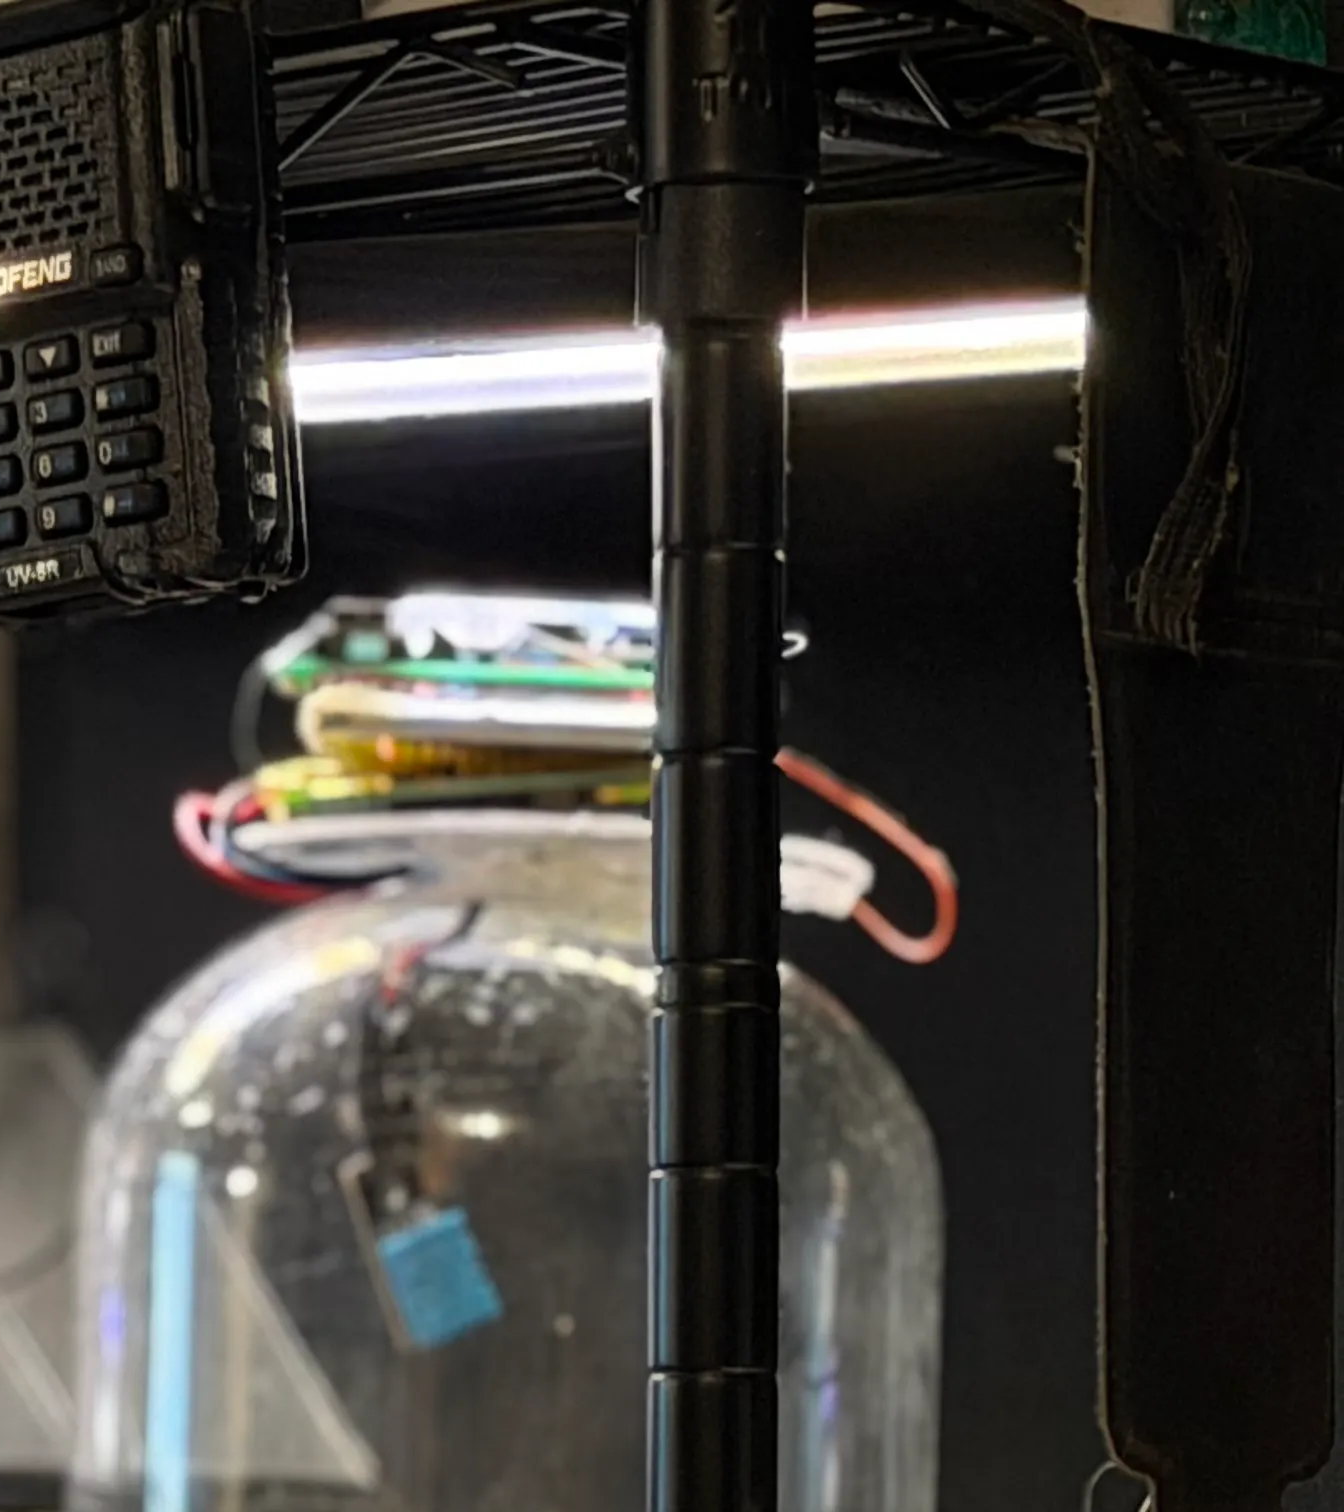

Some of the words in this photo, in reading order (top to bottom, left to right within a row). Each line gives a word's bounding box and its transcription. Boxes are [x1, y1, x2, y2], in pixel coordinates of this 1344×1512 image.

[33, 400, 48, 424] 3
[98, 440, 112, 465] 0
[42, 506, 56, 530] 9
